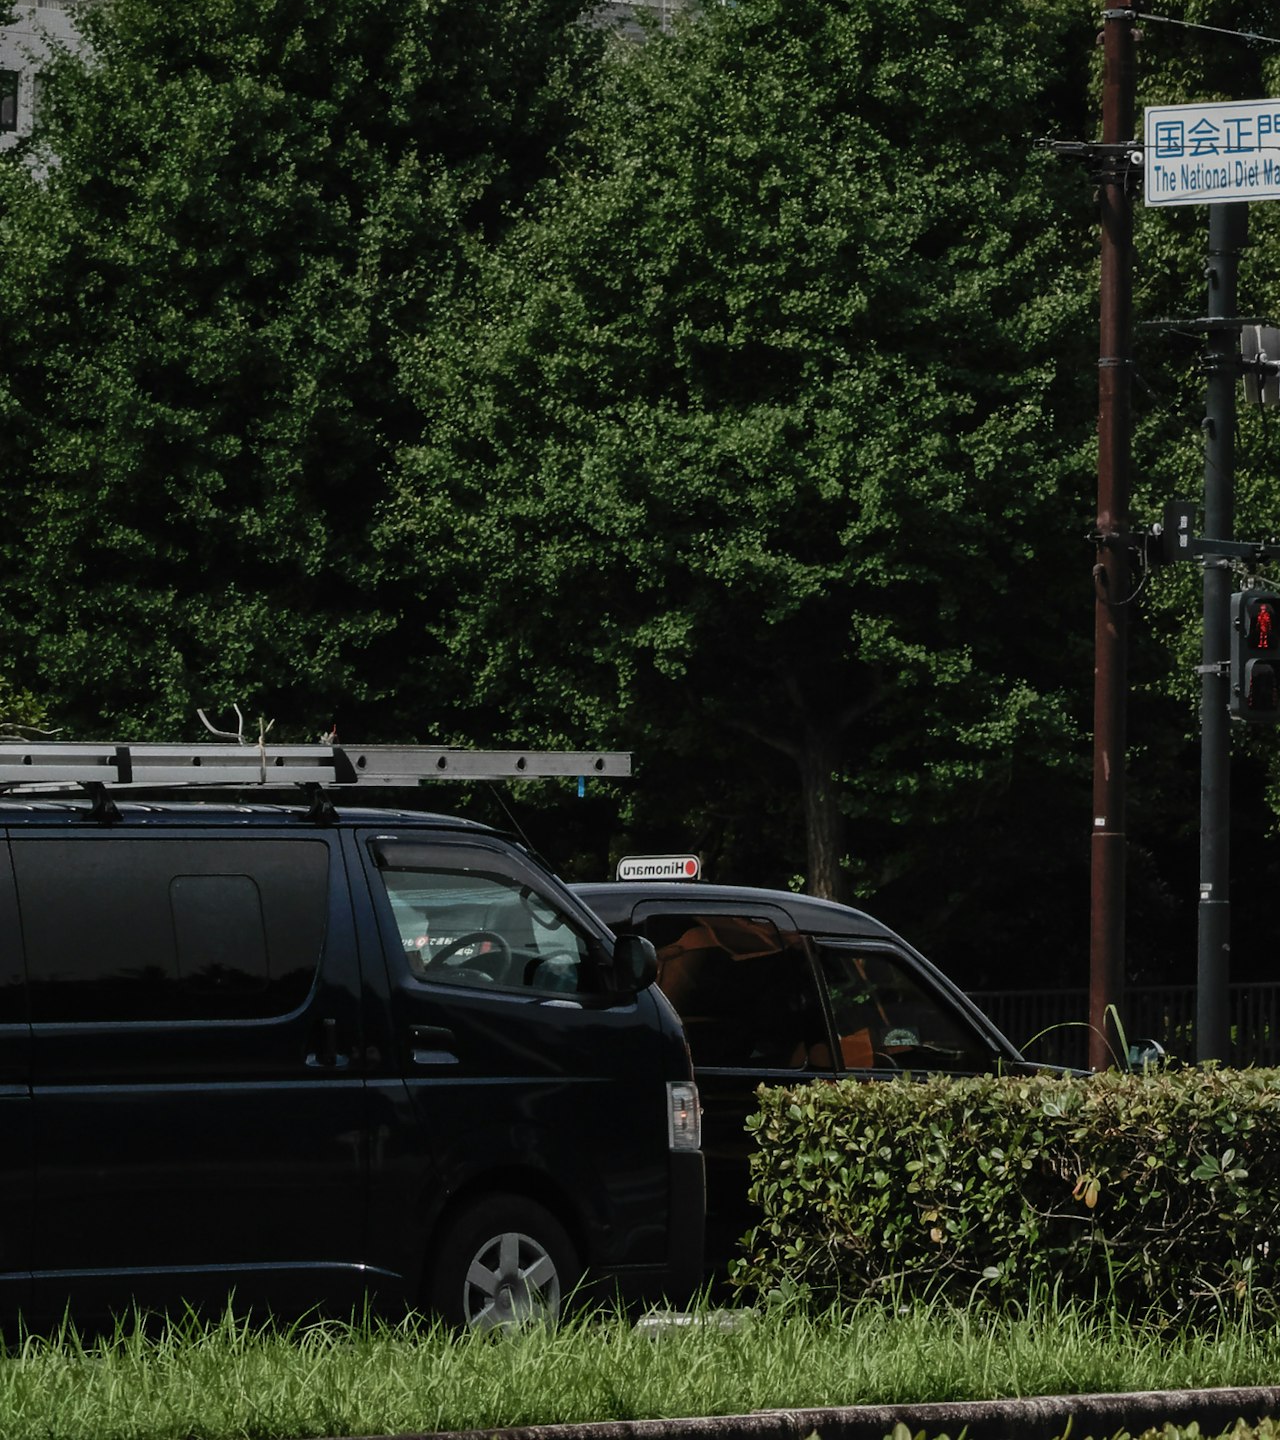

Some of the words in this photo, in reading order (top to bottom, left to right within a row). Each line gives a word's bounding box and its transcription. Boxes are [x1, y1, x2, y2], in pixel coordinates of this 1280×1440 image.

[1154, 165, 1176, 192] The
[1181, 161, 1231, 191] National
[1235, 160, 1260, 187] Diet
